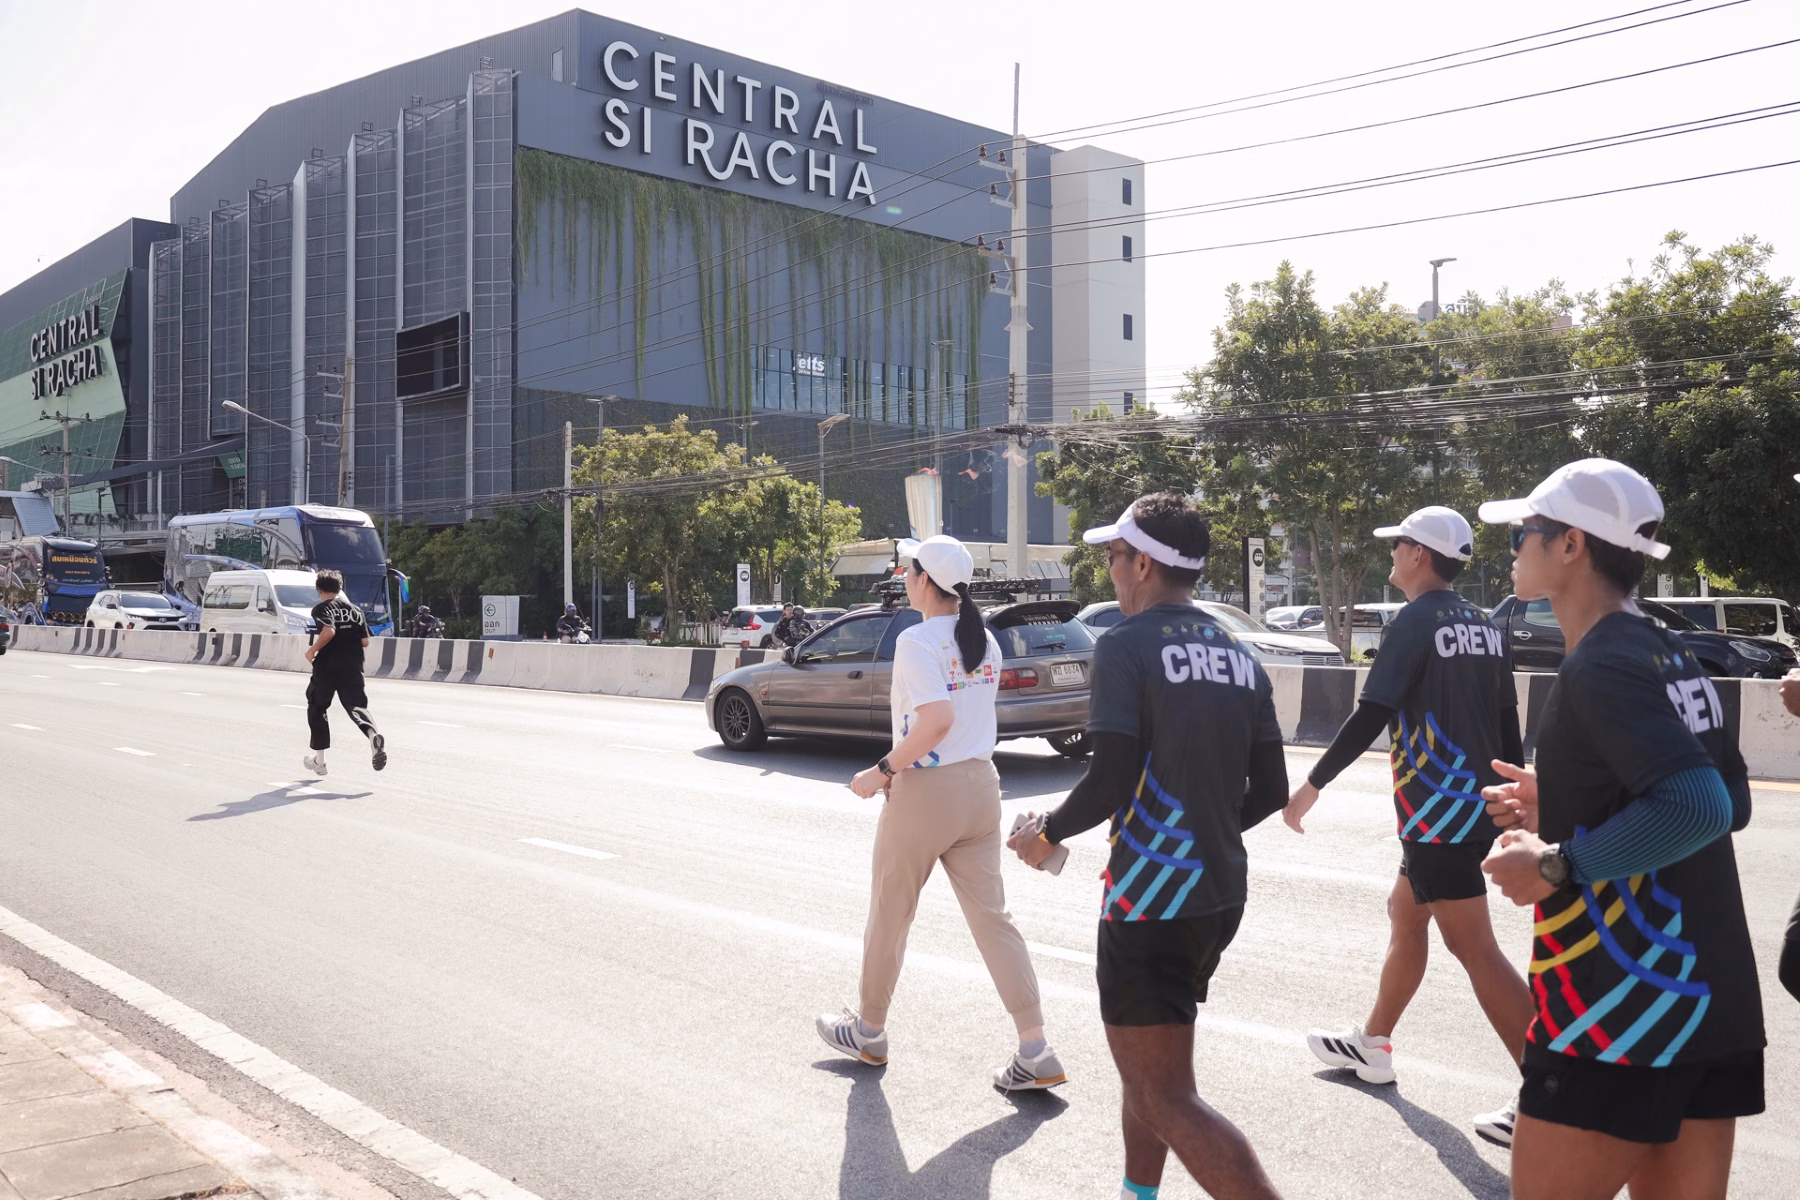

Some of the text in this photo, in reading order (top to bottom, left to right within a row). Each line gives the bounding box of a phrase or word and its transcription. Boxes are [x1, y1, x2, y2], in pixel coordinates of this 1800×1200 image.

[603, 40, 877, 154] CENTRAL
[603, 98, 877, 205] SI RACHA
[31, 304, 100, 363] CENTRAL
[32, 345, 100, 400] SI RACHA
[484, 620, 500, 628] ออก
[1435, 623, 1503, 658] CREW
[1161, 642, 1255, 691] CREW
